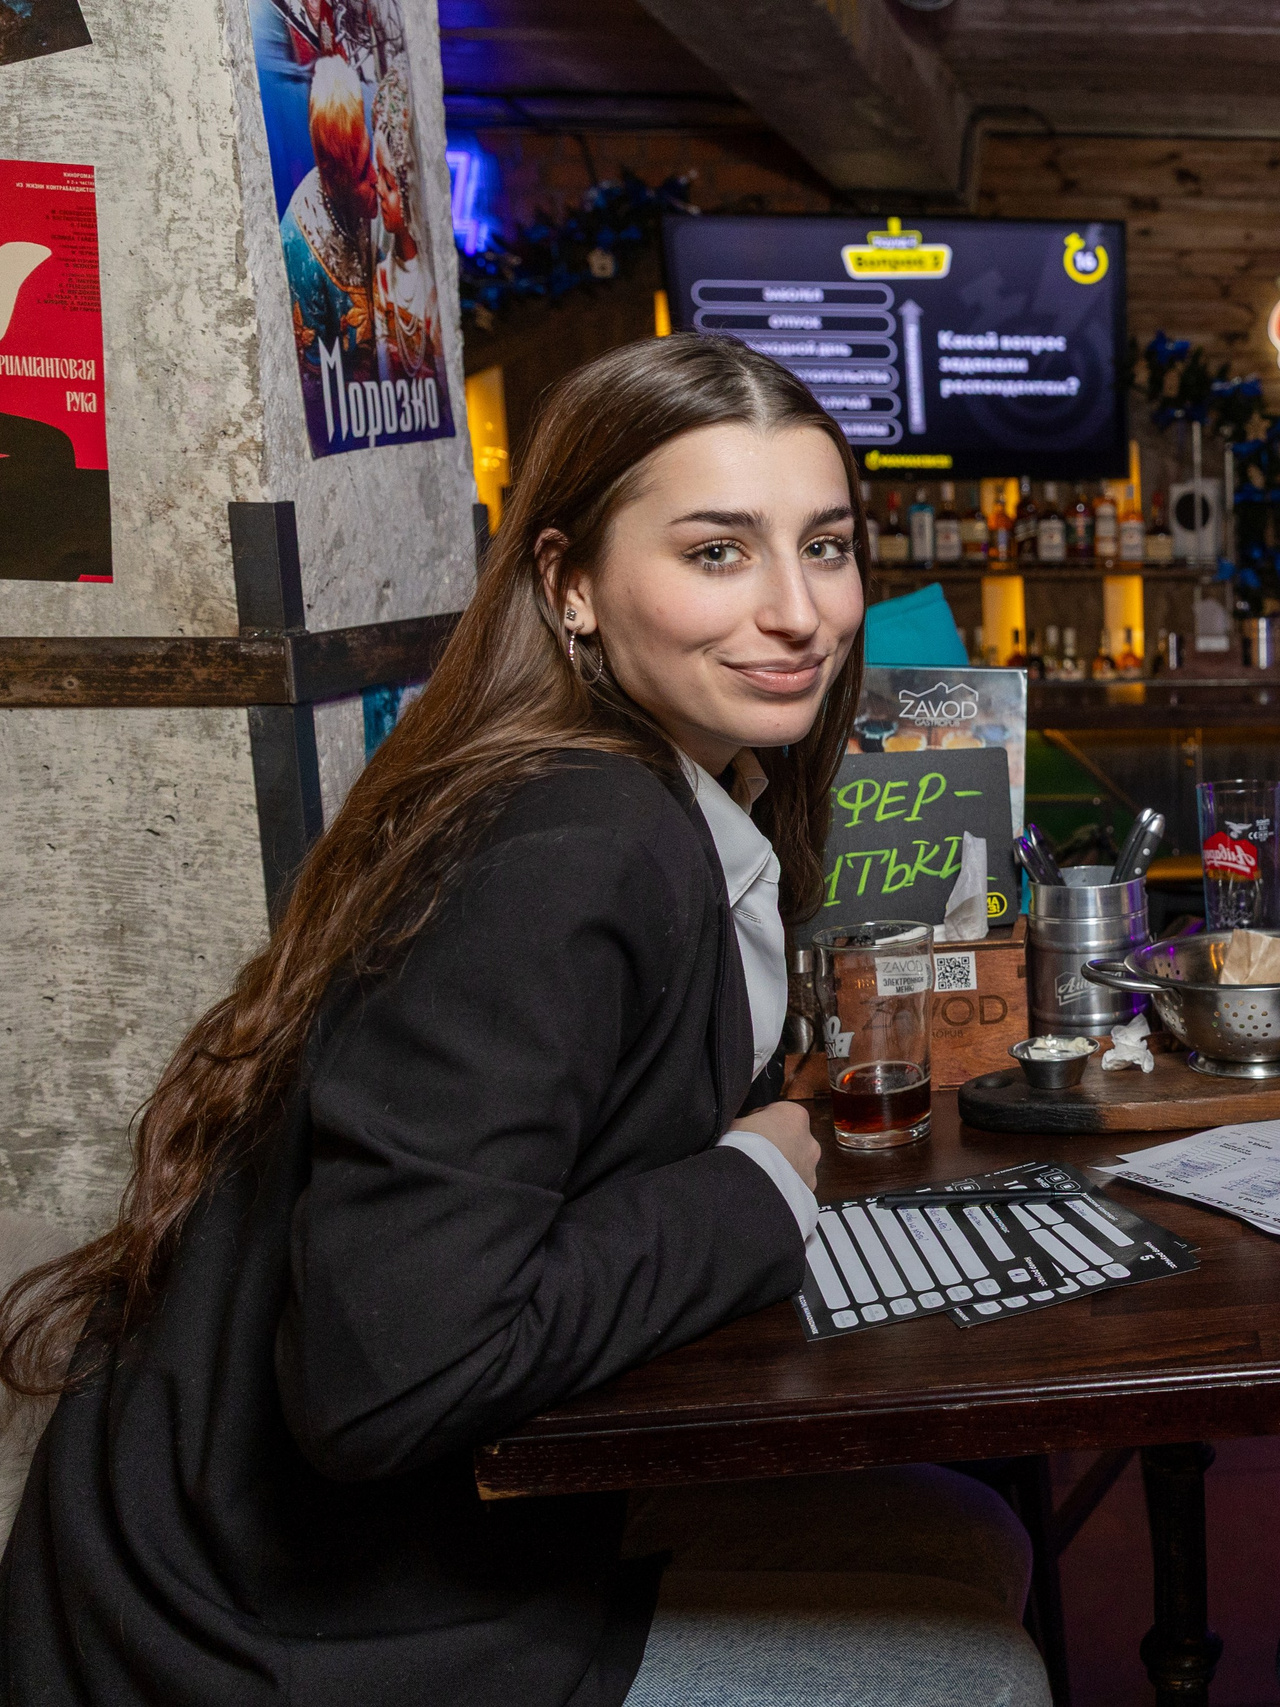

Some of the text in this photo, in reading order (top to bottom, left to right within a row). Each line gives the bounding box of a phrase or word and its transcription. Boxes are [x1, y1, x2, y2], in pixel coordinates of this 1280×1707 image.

[1075, 251, 1097, 271] 16
[768, 314, 822, 329] ОТПУСК
[938, 330, 1066, 355] Какой вопрос
[939, 356, 1028, 374] задавали
[317, 336, 440, 449] Морозко
[940, 376, 1080, 398] респондентам?
[899, 699, 979, 720] ZAVOD
[914, 719, 961, 727] GASTROPUB
[831, 772, 983, 828] ФЕР-
[882, 960, 924, 974] ZAVOD
[895, 985, 915, 993] МЕНЮ
